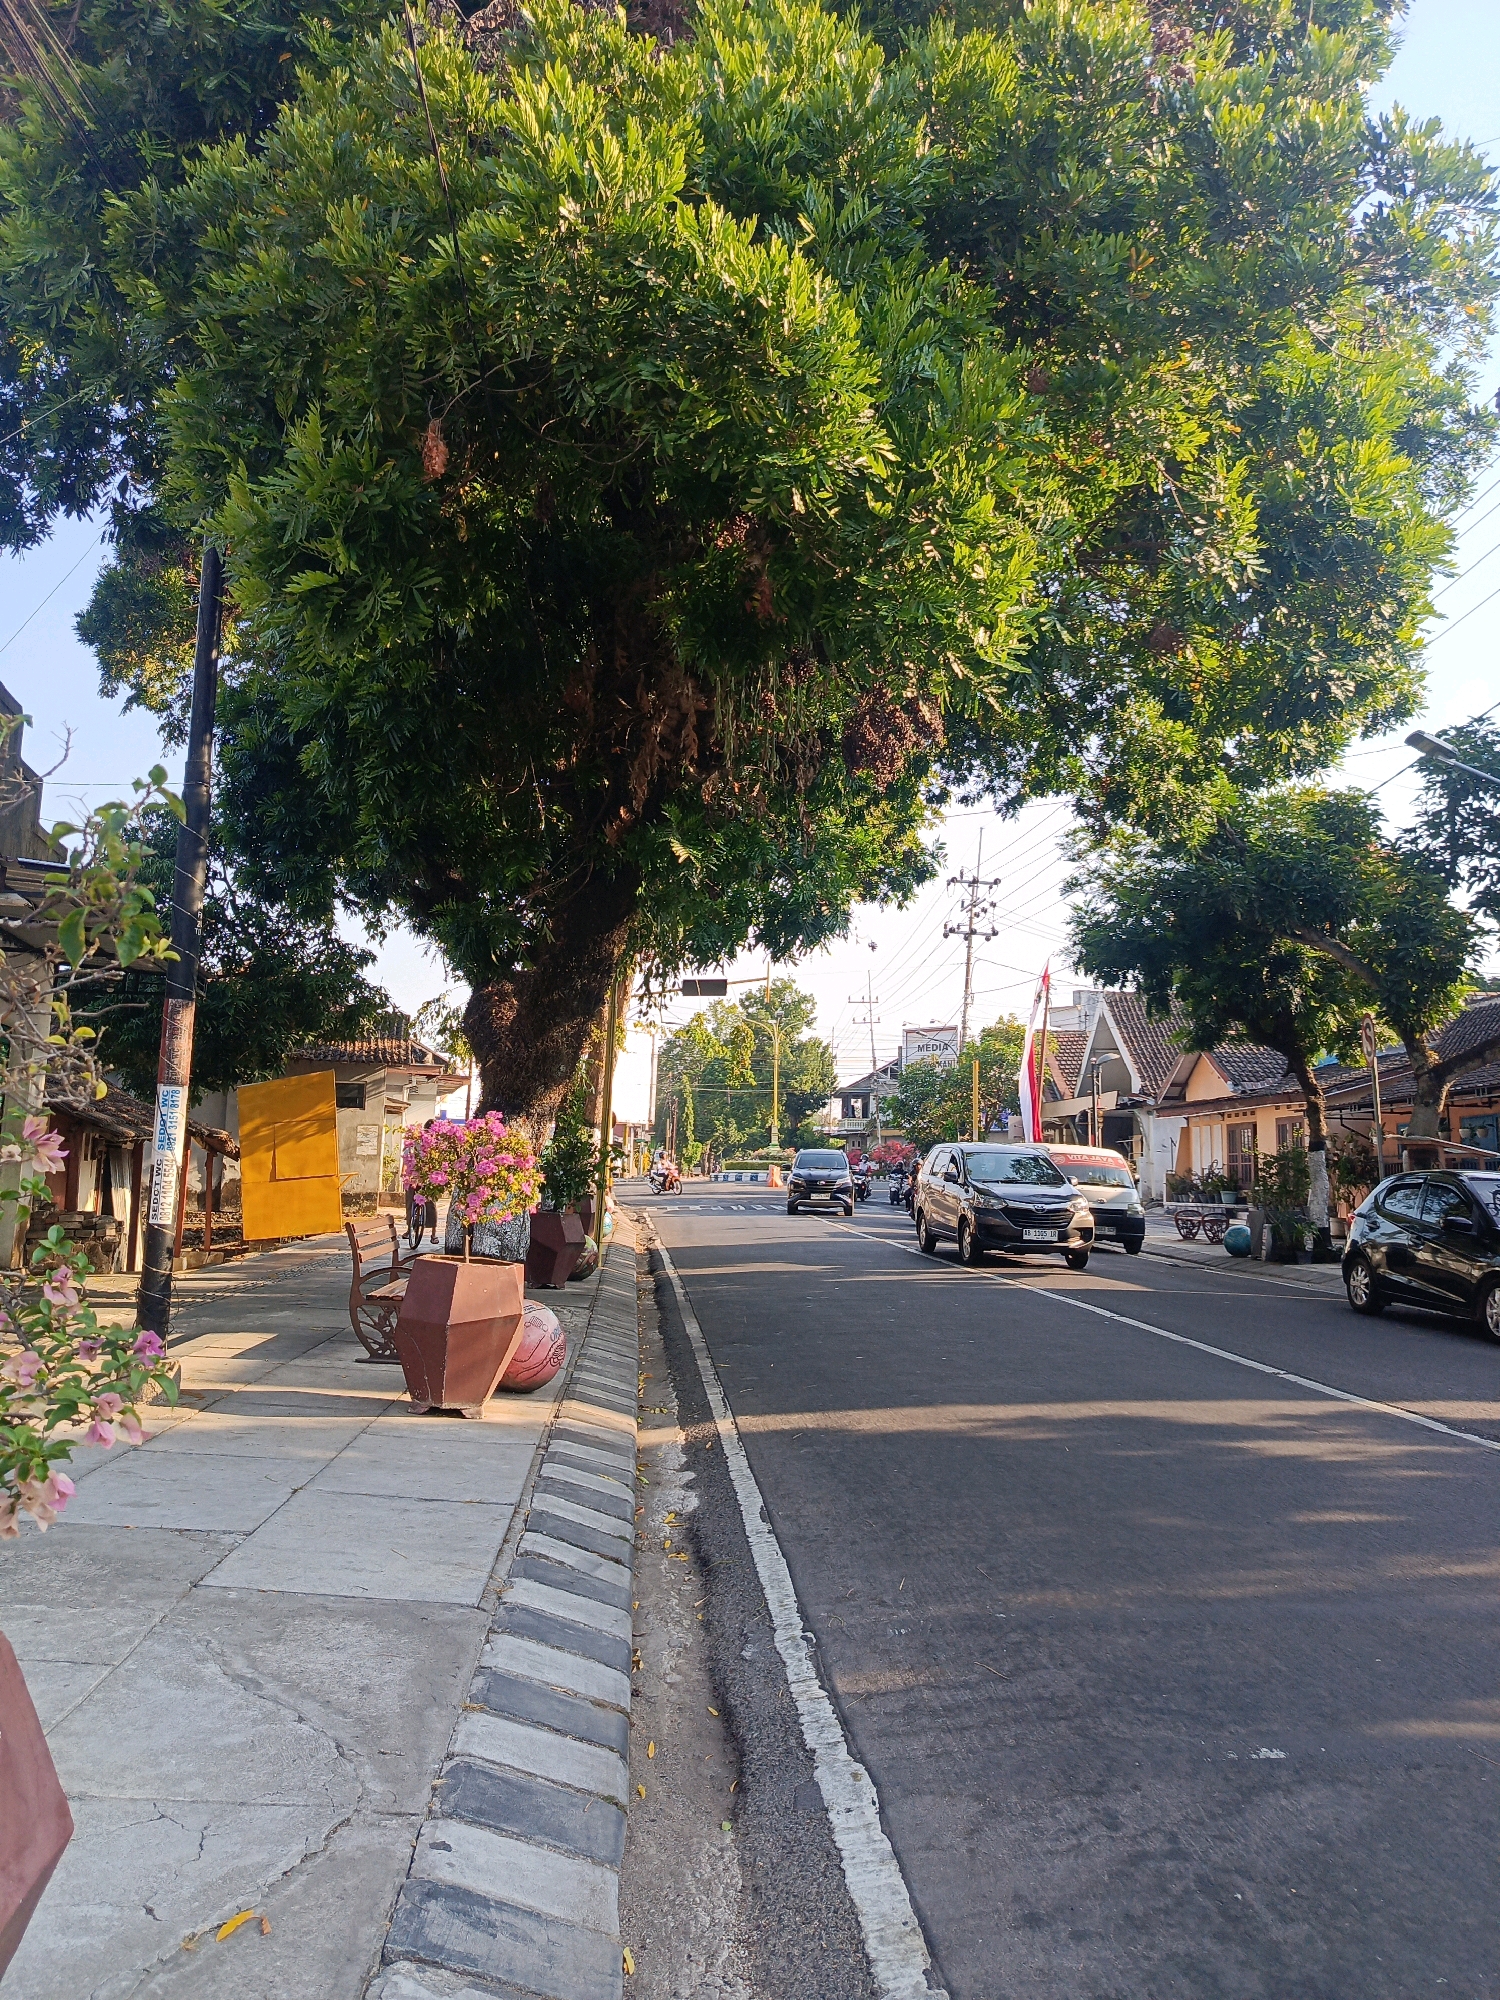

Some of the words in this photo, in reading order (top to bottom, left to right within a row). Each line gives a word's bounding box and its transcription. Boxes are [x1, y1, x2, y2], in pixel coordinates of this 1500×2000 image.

[917, 1043, 949, 1052] MEDIA
[161, 1090, 169, 1108] WC
[170, 1090, 181, 1108] 8178
[157, 1113, 167, 1151] SEDOT
[155, 1159, 162, 1177] WC
[1090, 1155, 1114, 1163] JAYA
[161, 1180, 173, 1199] 1104
[151, 1181, 160, 1221] SEDOT
[159, 1202, 171, 1221] 0812
